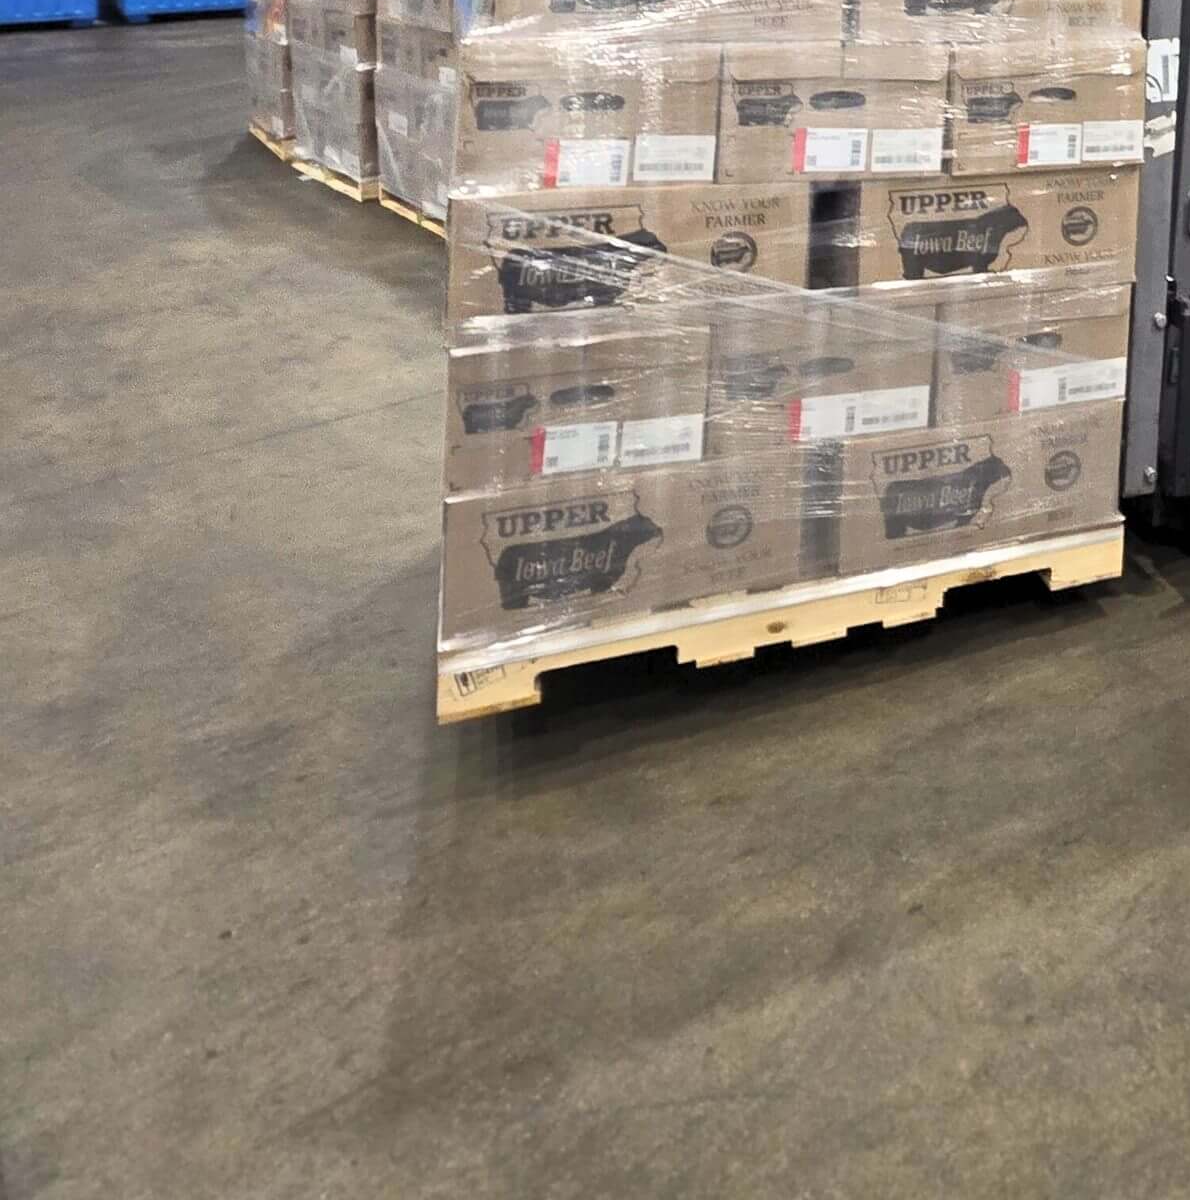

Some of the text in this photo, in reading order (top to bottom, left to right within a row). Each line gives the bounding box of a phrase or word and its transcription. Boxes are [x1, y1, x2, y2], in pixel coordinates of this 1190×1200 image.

[899, 190, 990, 216] UPPER
[705, 213, 766, 228] FARMER
[912, 228, 992, 255] Iowa Beef
[883, 443, 972, 476] UPPER
[938, 483, 976, 508] Beef
[496, 502, 611, 538] UPPER
[514, 541, 616, 582] Iowa Beef
